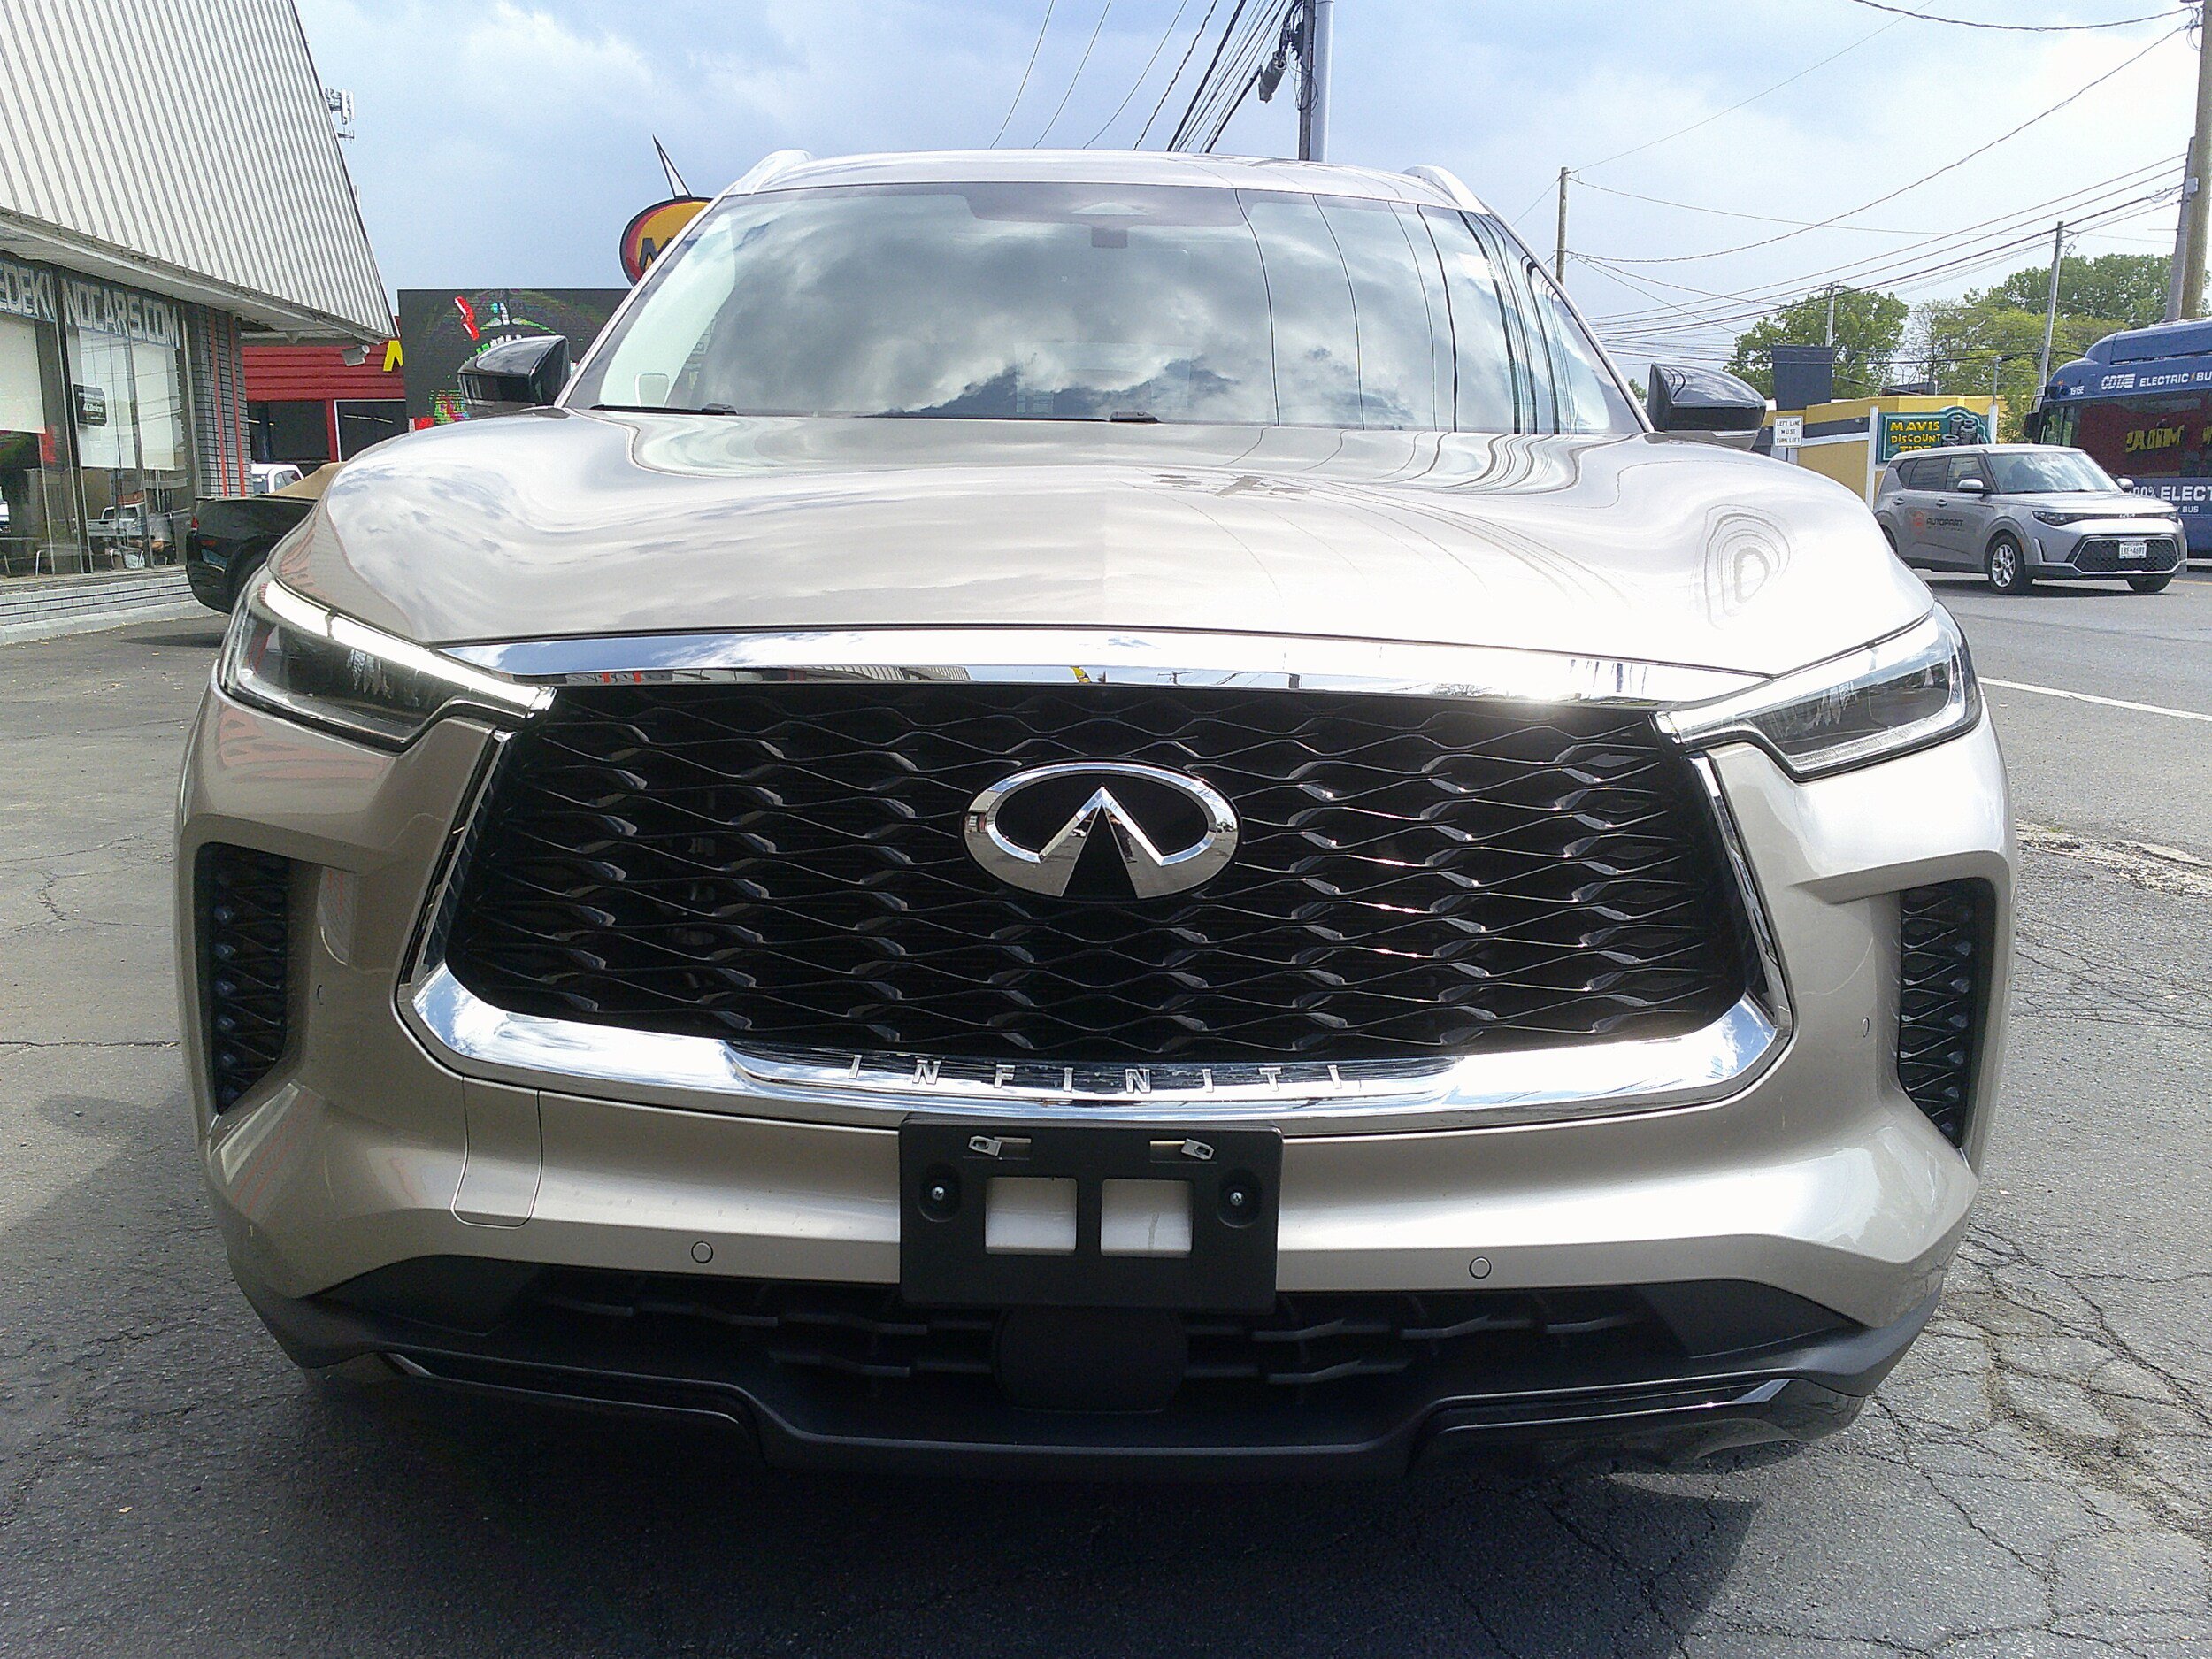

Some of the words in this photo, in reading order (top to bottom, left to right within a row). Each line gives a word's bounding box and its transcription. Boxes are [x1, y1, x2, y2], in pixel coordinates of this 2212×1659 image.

[2139, 373, 2190, 388] ELECTRIC
[1890, 421, 1940, 431] MAVIS
[1890, 434, 1941, 444] DISCOUNT
[847, 1054, 1343, 1094] INFINITI
